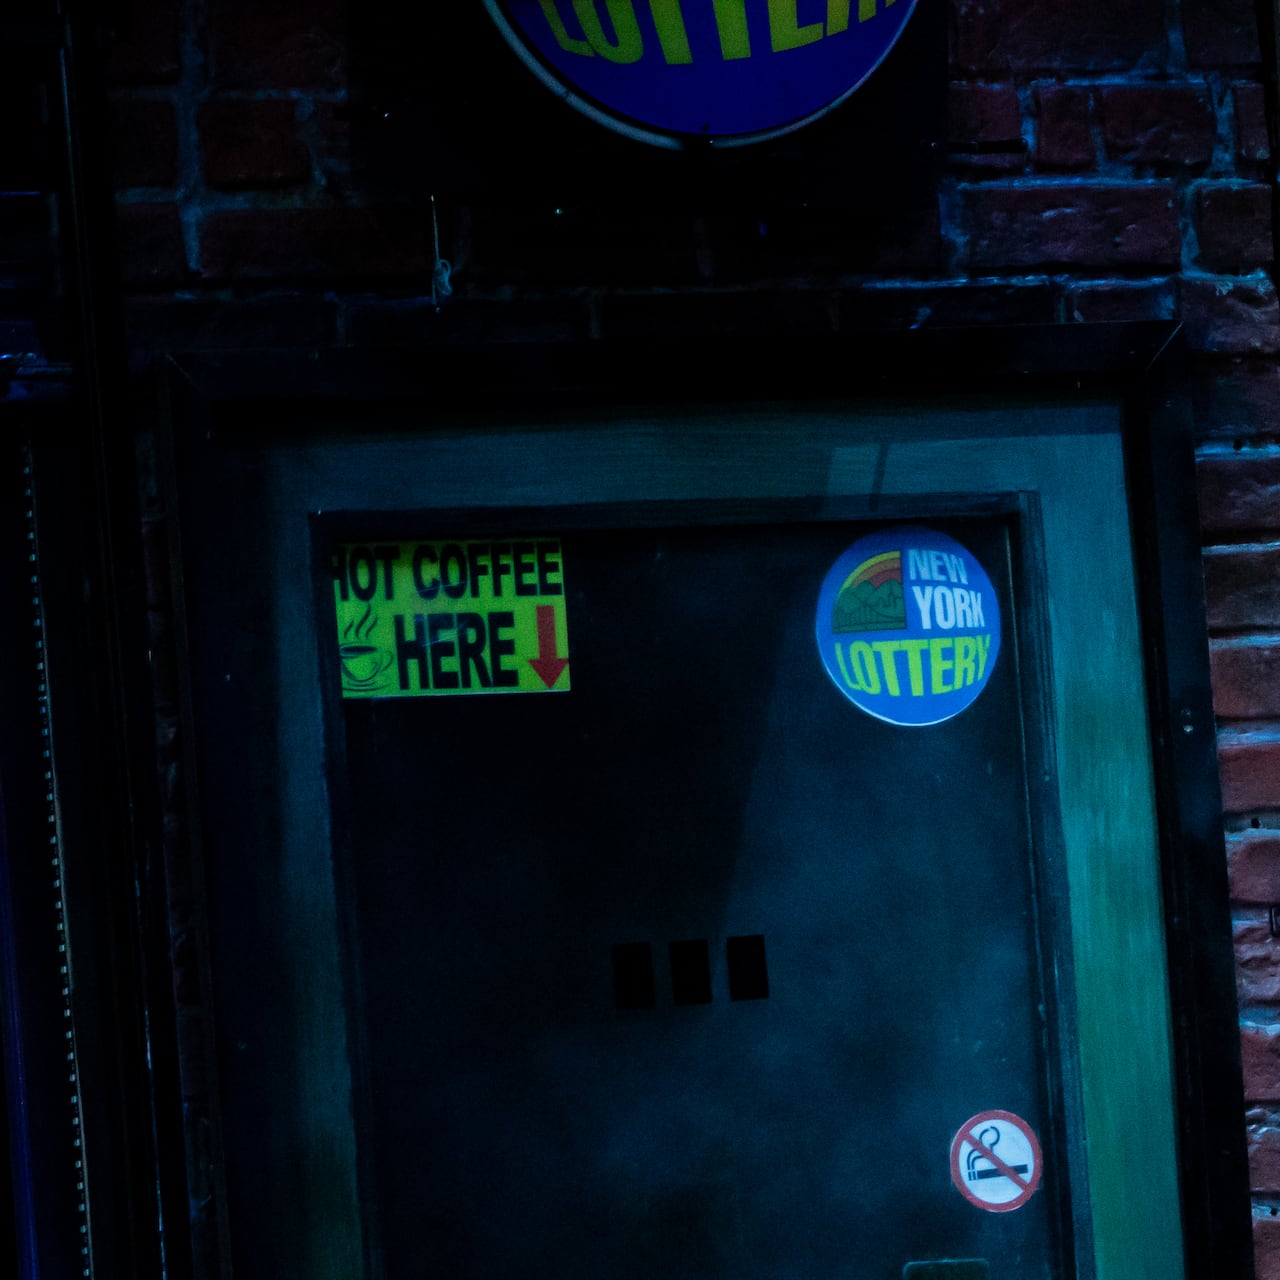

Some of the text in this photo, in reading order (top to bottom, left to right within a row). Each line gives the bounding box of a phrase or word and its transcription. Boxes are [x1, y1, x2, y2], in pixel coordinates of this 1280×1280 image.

[412, 541, 563, 600] COFFEE
[907, 548, 969, 585] NEW
[911, 585, 986, 631] YORK
[393, 611, 520, 691] HERE
[834, 633, 992, 697] LOTTERY
